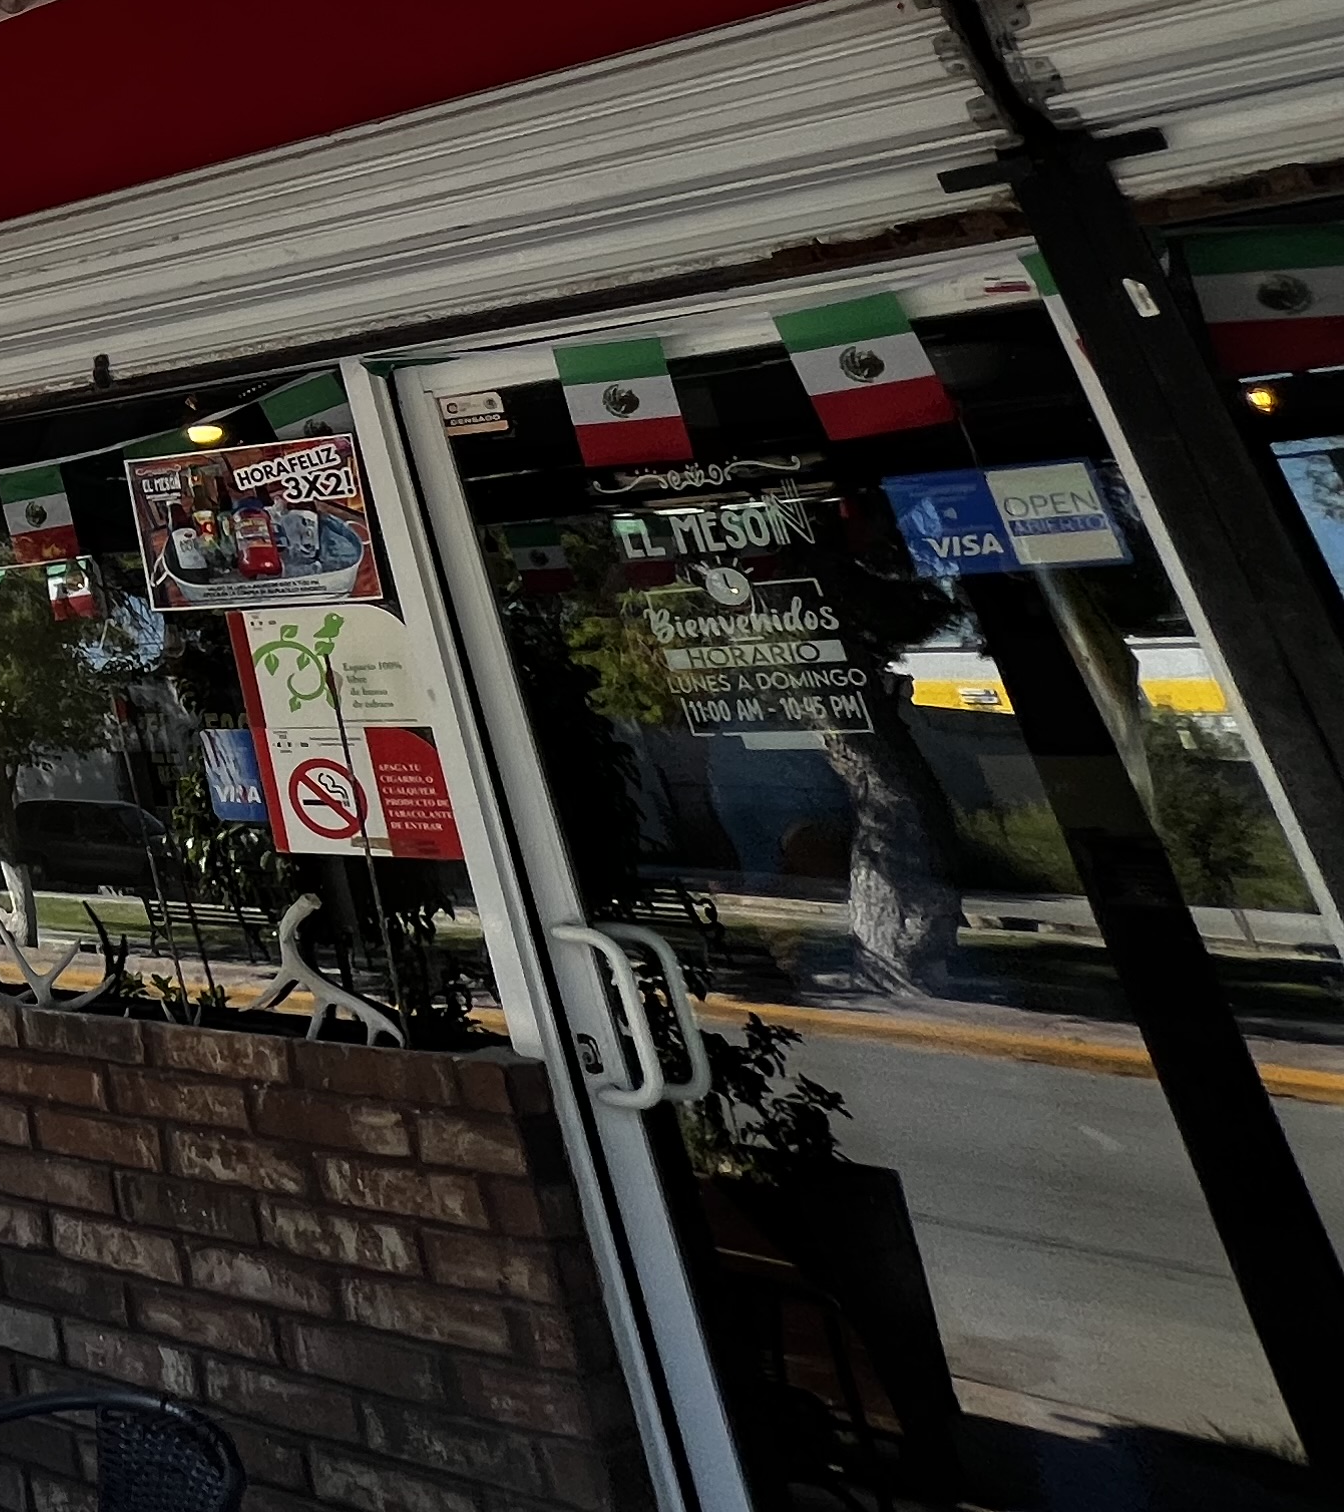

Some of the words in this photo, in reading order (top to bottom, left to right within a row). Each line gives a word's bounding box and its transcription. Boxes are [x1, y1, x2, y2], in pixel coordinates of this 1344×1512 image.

[284, 469, 355, 500] 3X2!
[1003, 490, 1099, 517] OPEN
[617, 519, 666, 559] EL
[921, 533, 1004, 558] VISA
[643, 596, 839, 643] Bienvenidos
[686, 641, 821, 670] HORARIO
[666, 674, 731, 694] LUNES
[738, 675, 755, 692] A
[755, 668, 868, 691] DOMINGO
[736, 697, 763, 722] AM
[830, 694, 863, 719] PM
